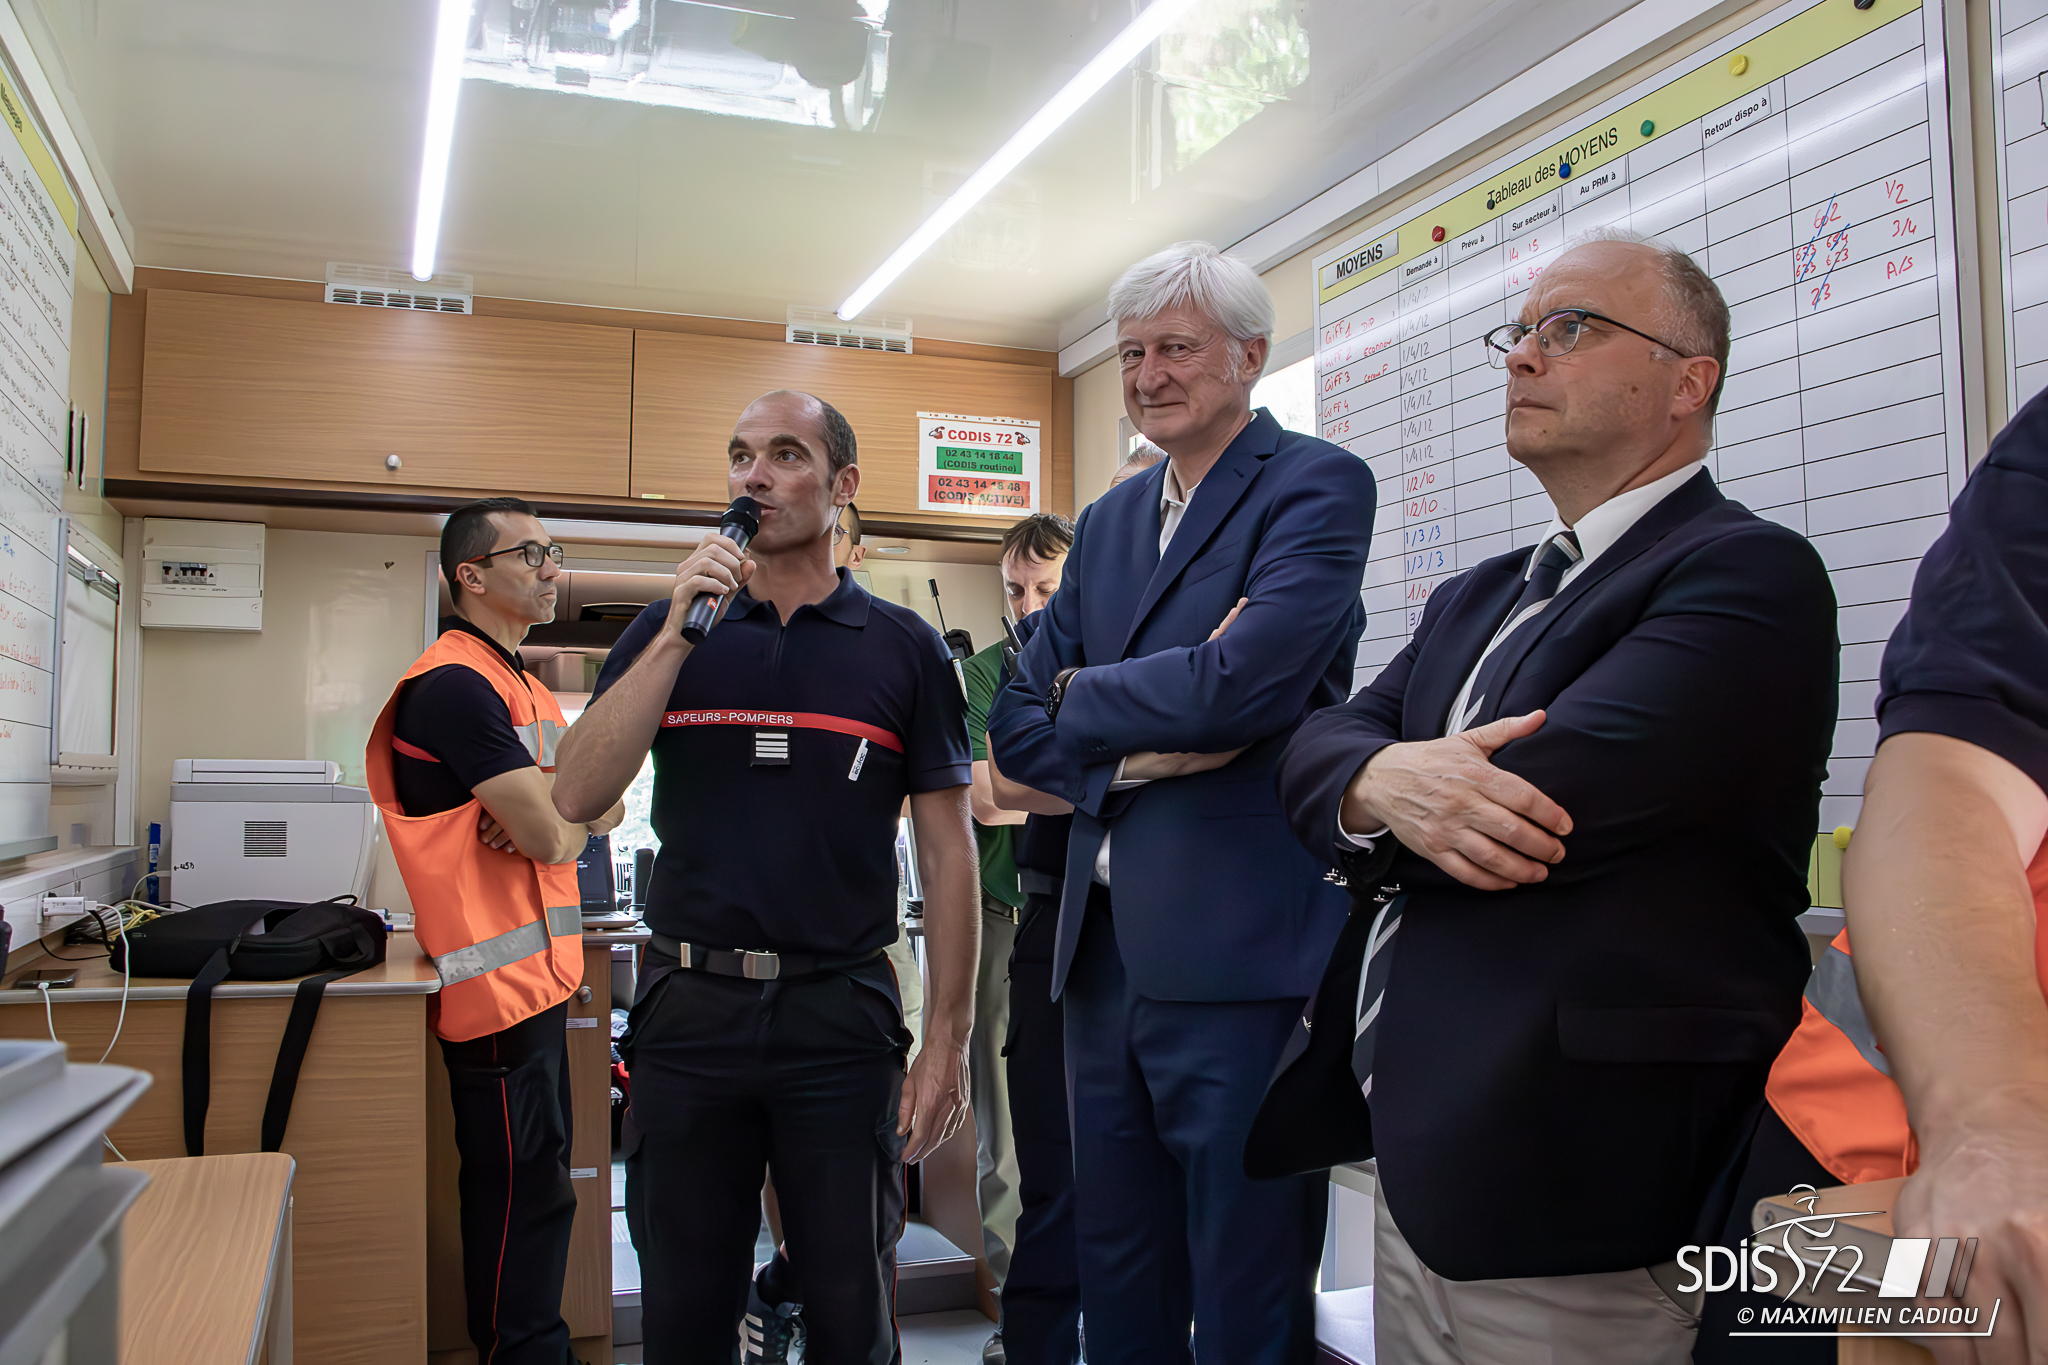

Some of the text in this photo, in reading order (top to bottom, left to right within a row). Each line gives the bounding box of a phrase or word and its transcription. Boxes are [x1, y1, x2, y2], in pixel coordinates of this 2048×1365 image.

[1704, 97, 1767, 139] Retour dispo à
[1487, 127, 1618, 204] Tableau des MOYENS
[1580, 171, 1616, 196] Au PRM à
[1885, 179, 1908, 204] 1/2
[1512, 204, 1557, 232] Sur secteur à
[1892, 217, 1917, 237] 3/4
[1461, 234, 1485, 250] Prévu à
[1509, 238, 1539, 262] 14 15
[1336, 243, 1383, 279] MOYENS
[1406, 255, 1438, 276] Demandé à
[1507, 266, 1543, 288] 14 30
[948, 430, 1012, 444] CODIS 72
[945, 449, 1014, 461] 02 43 14 18 44
[943, 460, 1017, 473] (CODIS routine)
[938, 478, 1021, 491] 02 43 14 18 48
[1406, 471, 1435, 492] 1/2/10
[934, 490, 1024, 506] (CODIS ACTIVE)
[1406, 497, 1438, 518] 1/2/10
[1406, 525, 1441, 547] 1/3/3
[1407, 550, 1444, 575] 1/3/3
[668, 712, 793, 725] SAPEURS-POMPIERS
